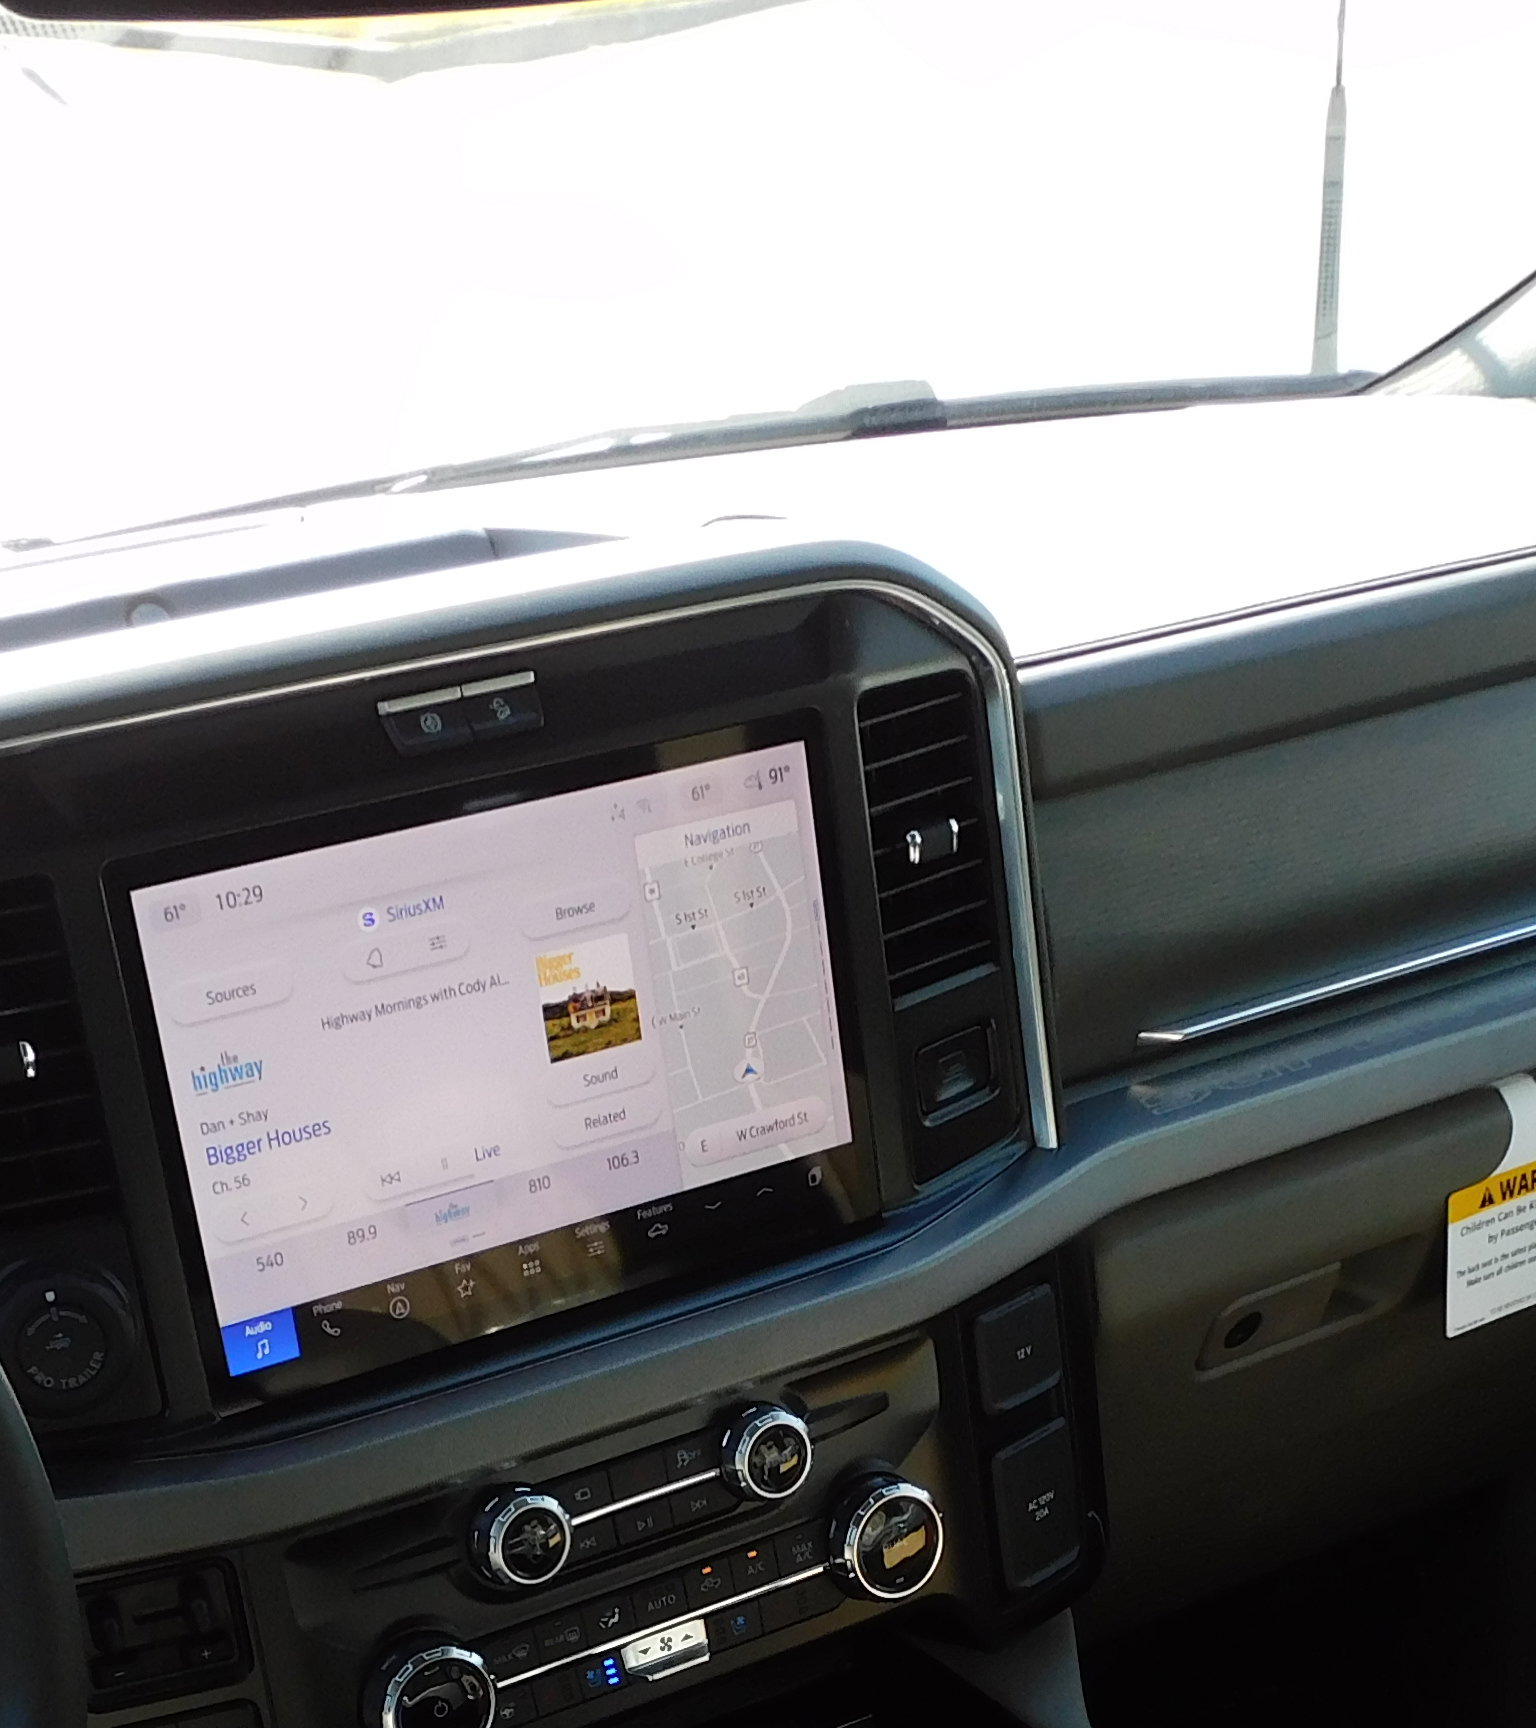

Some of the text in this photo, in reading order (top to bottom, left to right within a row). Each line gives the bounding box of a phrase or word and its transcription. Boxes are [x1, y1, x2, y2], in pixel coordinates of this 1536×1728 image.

[768, 765, 791, 784] 91°
[684, 821, 752, 849] Navigation
[215, 885, 264, 912] 10:29
[164, 903, 186, 923] 61°
[386, 895, 445, 923] SiriusXM
[555, 900, 596, 922] Browse
[205, 982, 257, 1006] Sources
[320, 1006, 373, 1032] Highway
[374, 993, 429, 1017] Mornings
[429, 984, 457, 1004] with
[458, 978, 487, 998] Cody
[220, 1051, 239, 1066] the
[191, 1059, 264, 1093] highway
[582, 1067, 619, 1088] Sound
[200, 1118, 225, 1137] Dan
[238, 1107, 269, 1126] Shay
[583, 1108, 627, 1131] Related
[736, 1128, 748, 1143] W
[749, 1117, 796, 1139] Crawford
[797, 1111, 809, 1126] St
[206, 1118, 332, 1166] Bigger Houses
[474, 1143, 501, 1162] Live
[606, 1152, 640, 1172] 106.3
[212, 1173, 251, 1195] Ch. 56
[528, 1176, 551, 1195] 810
[636, 1202, 674, 1221] Features
[1460, 1216, 1496, 1237] Children
[1498, 1210, 1514, 1223] Can
[1516, 1206, 1527, 1217] Be
[346, 1225, 378, 1246] 89.9
[574, 1220, 612, 1239] Settings
[1488, 1233, 1498, 1244] by
[517, 1240, 541, 1257] Apps
[255, 1252, 284, 1272] 540
[454, 1261, 472, 1275] Fav
[386, 1281, 406, 1295] Nav
[312, 1299, 343, 1317] Phone
[244, 1319, 273, 1338] Audio
[60, 1351, 104, 1389] TRAILER
[746, 1561, 766, 1577] A/C
[647, 1593, 677, 1613] AUTO
